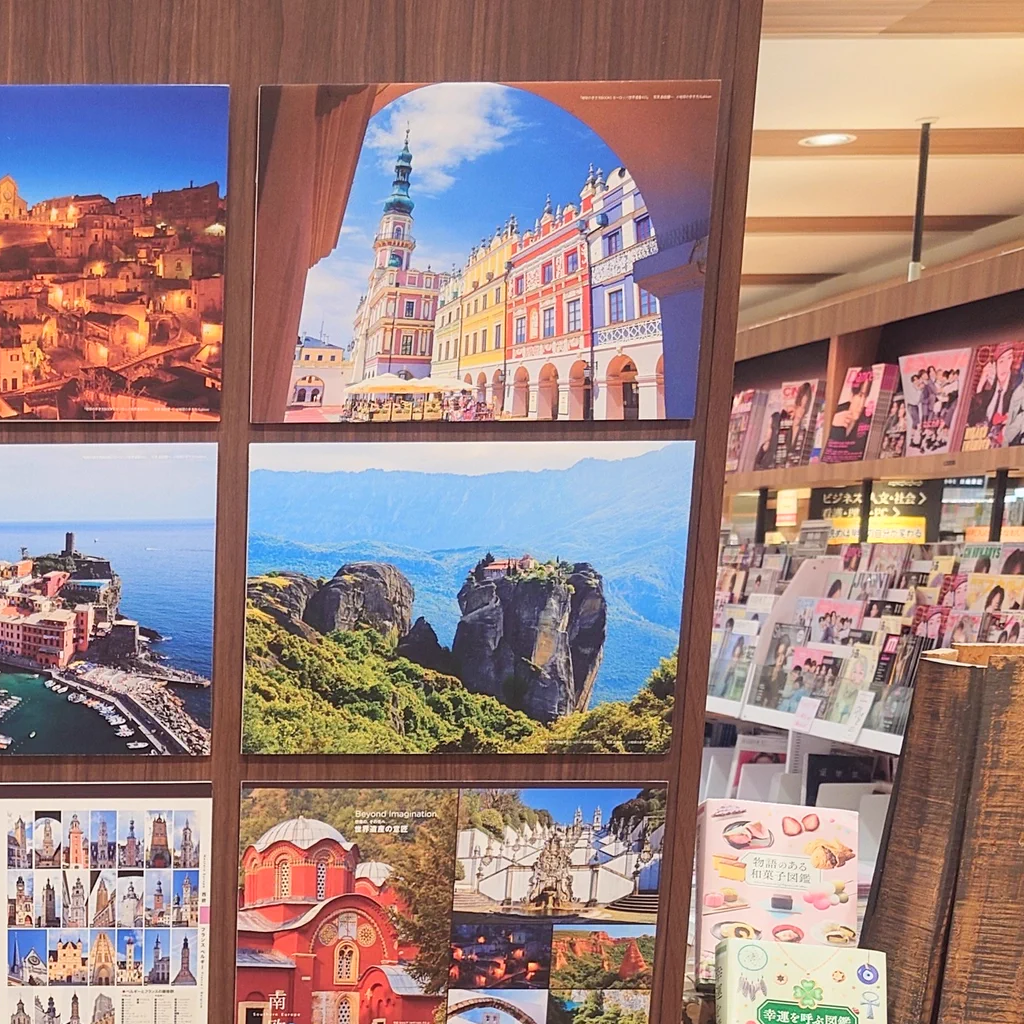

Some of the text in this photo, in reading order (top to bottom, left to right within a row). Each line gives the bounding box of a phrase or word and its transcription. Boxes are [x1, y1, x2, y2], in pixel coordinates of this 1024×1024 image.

[822, 493, 863, 504] ビジネス
[355, 810, 437, 818] Beyond Imagination
[753, 857, 807, 872] 物語のある
[751, 868, 811, 884] 和菓子図鑑
